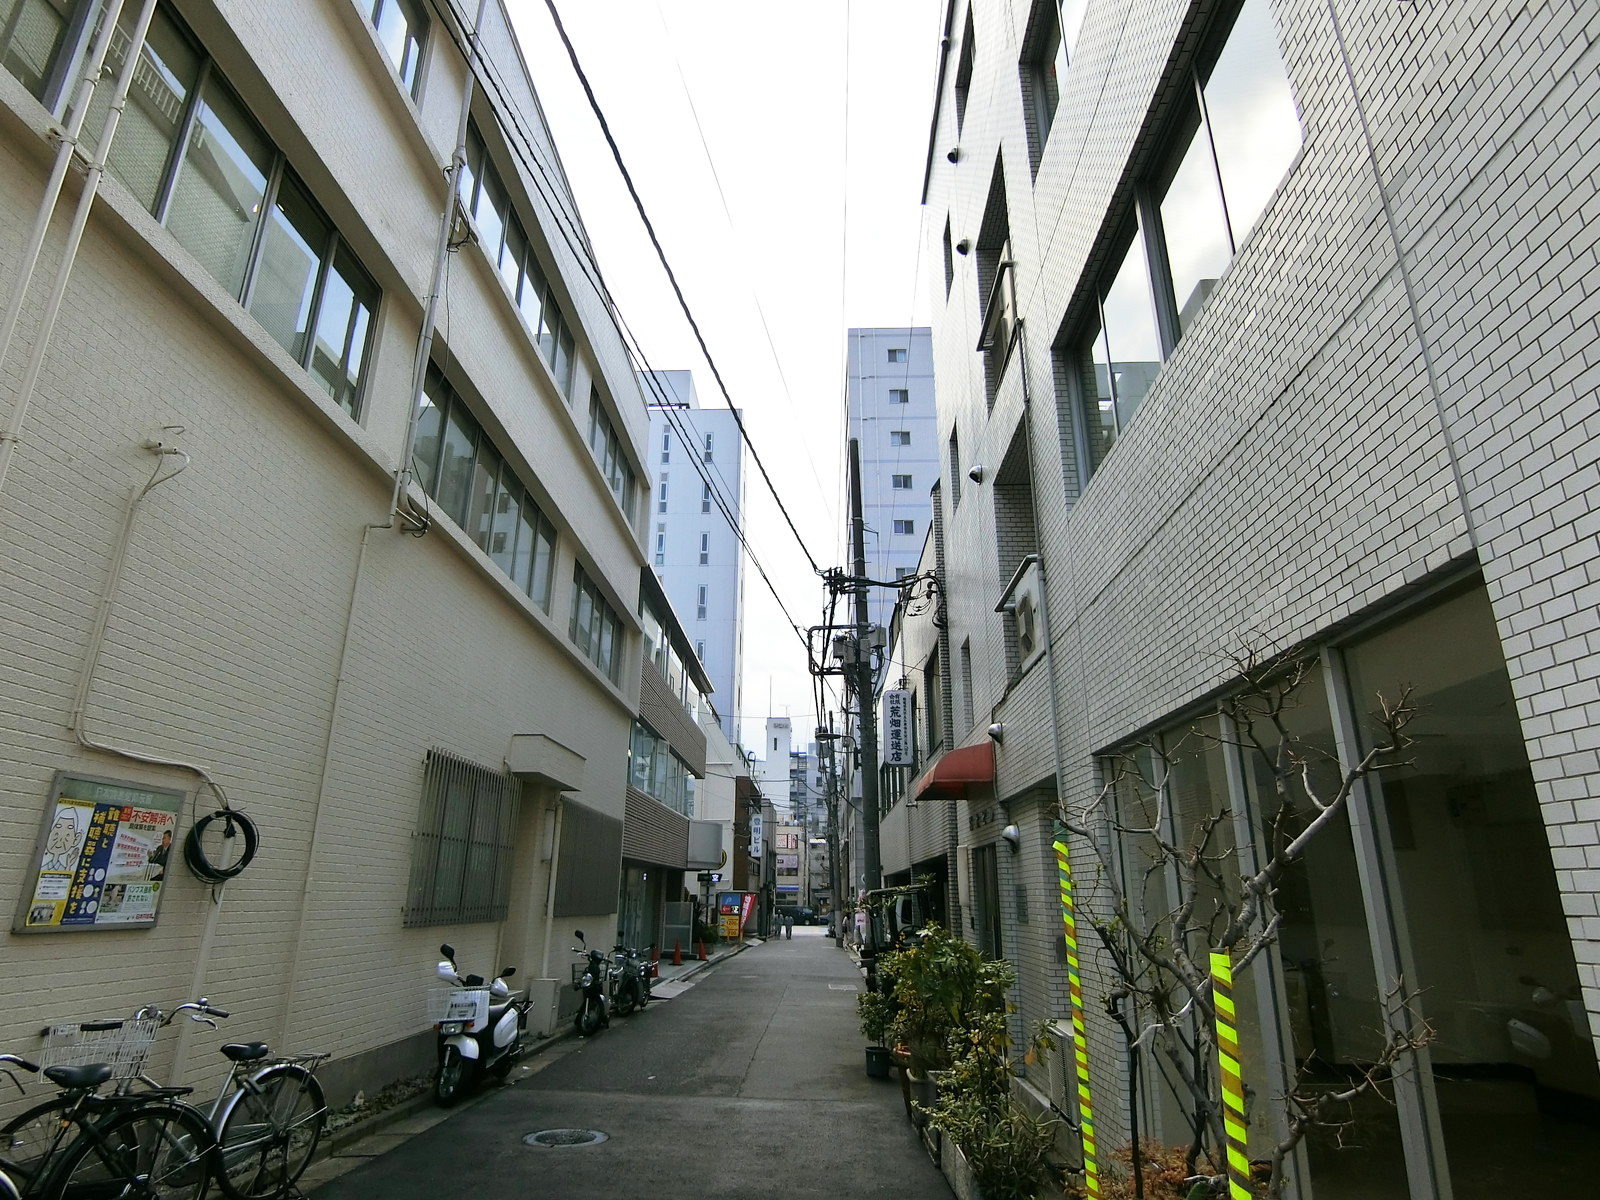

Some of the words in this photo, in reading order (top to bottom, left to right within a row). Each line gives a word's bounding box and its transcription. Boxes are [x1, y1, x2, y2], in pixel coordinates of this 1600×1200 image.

[889, 705, 903, 762] 荒畑運送店
[101, 807, 121, 849] 難聴と
[131, 809, 175, 826] 不安解消へ
[752, 817, 761, 853] 豊明ビル
[69, 811, 108, 915] 補聴器に支援を
